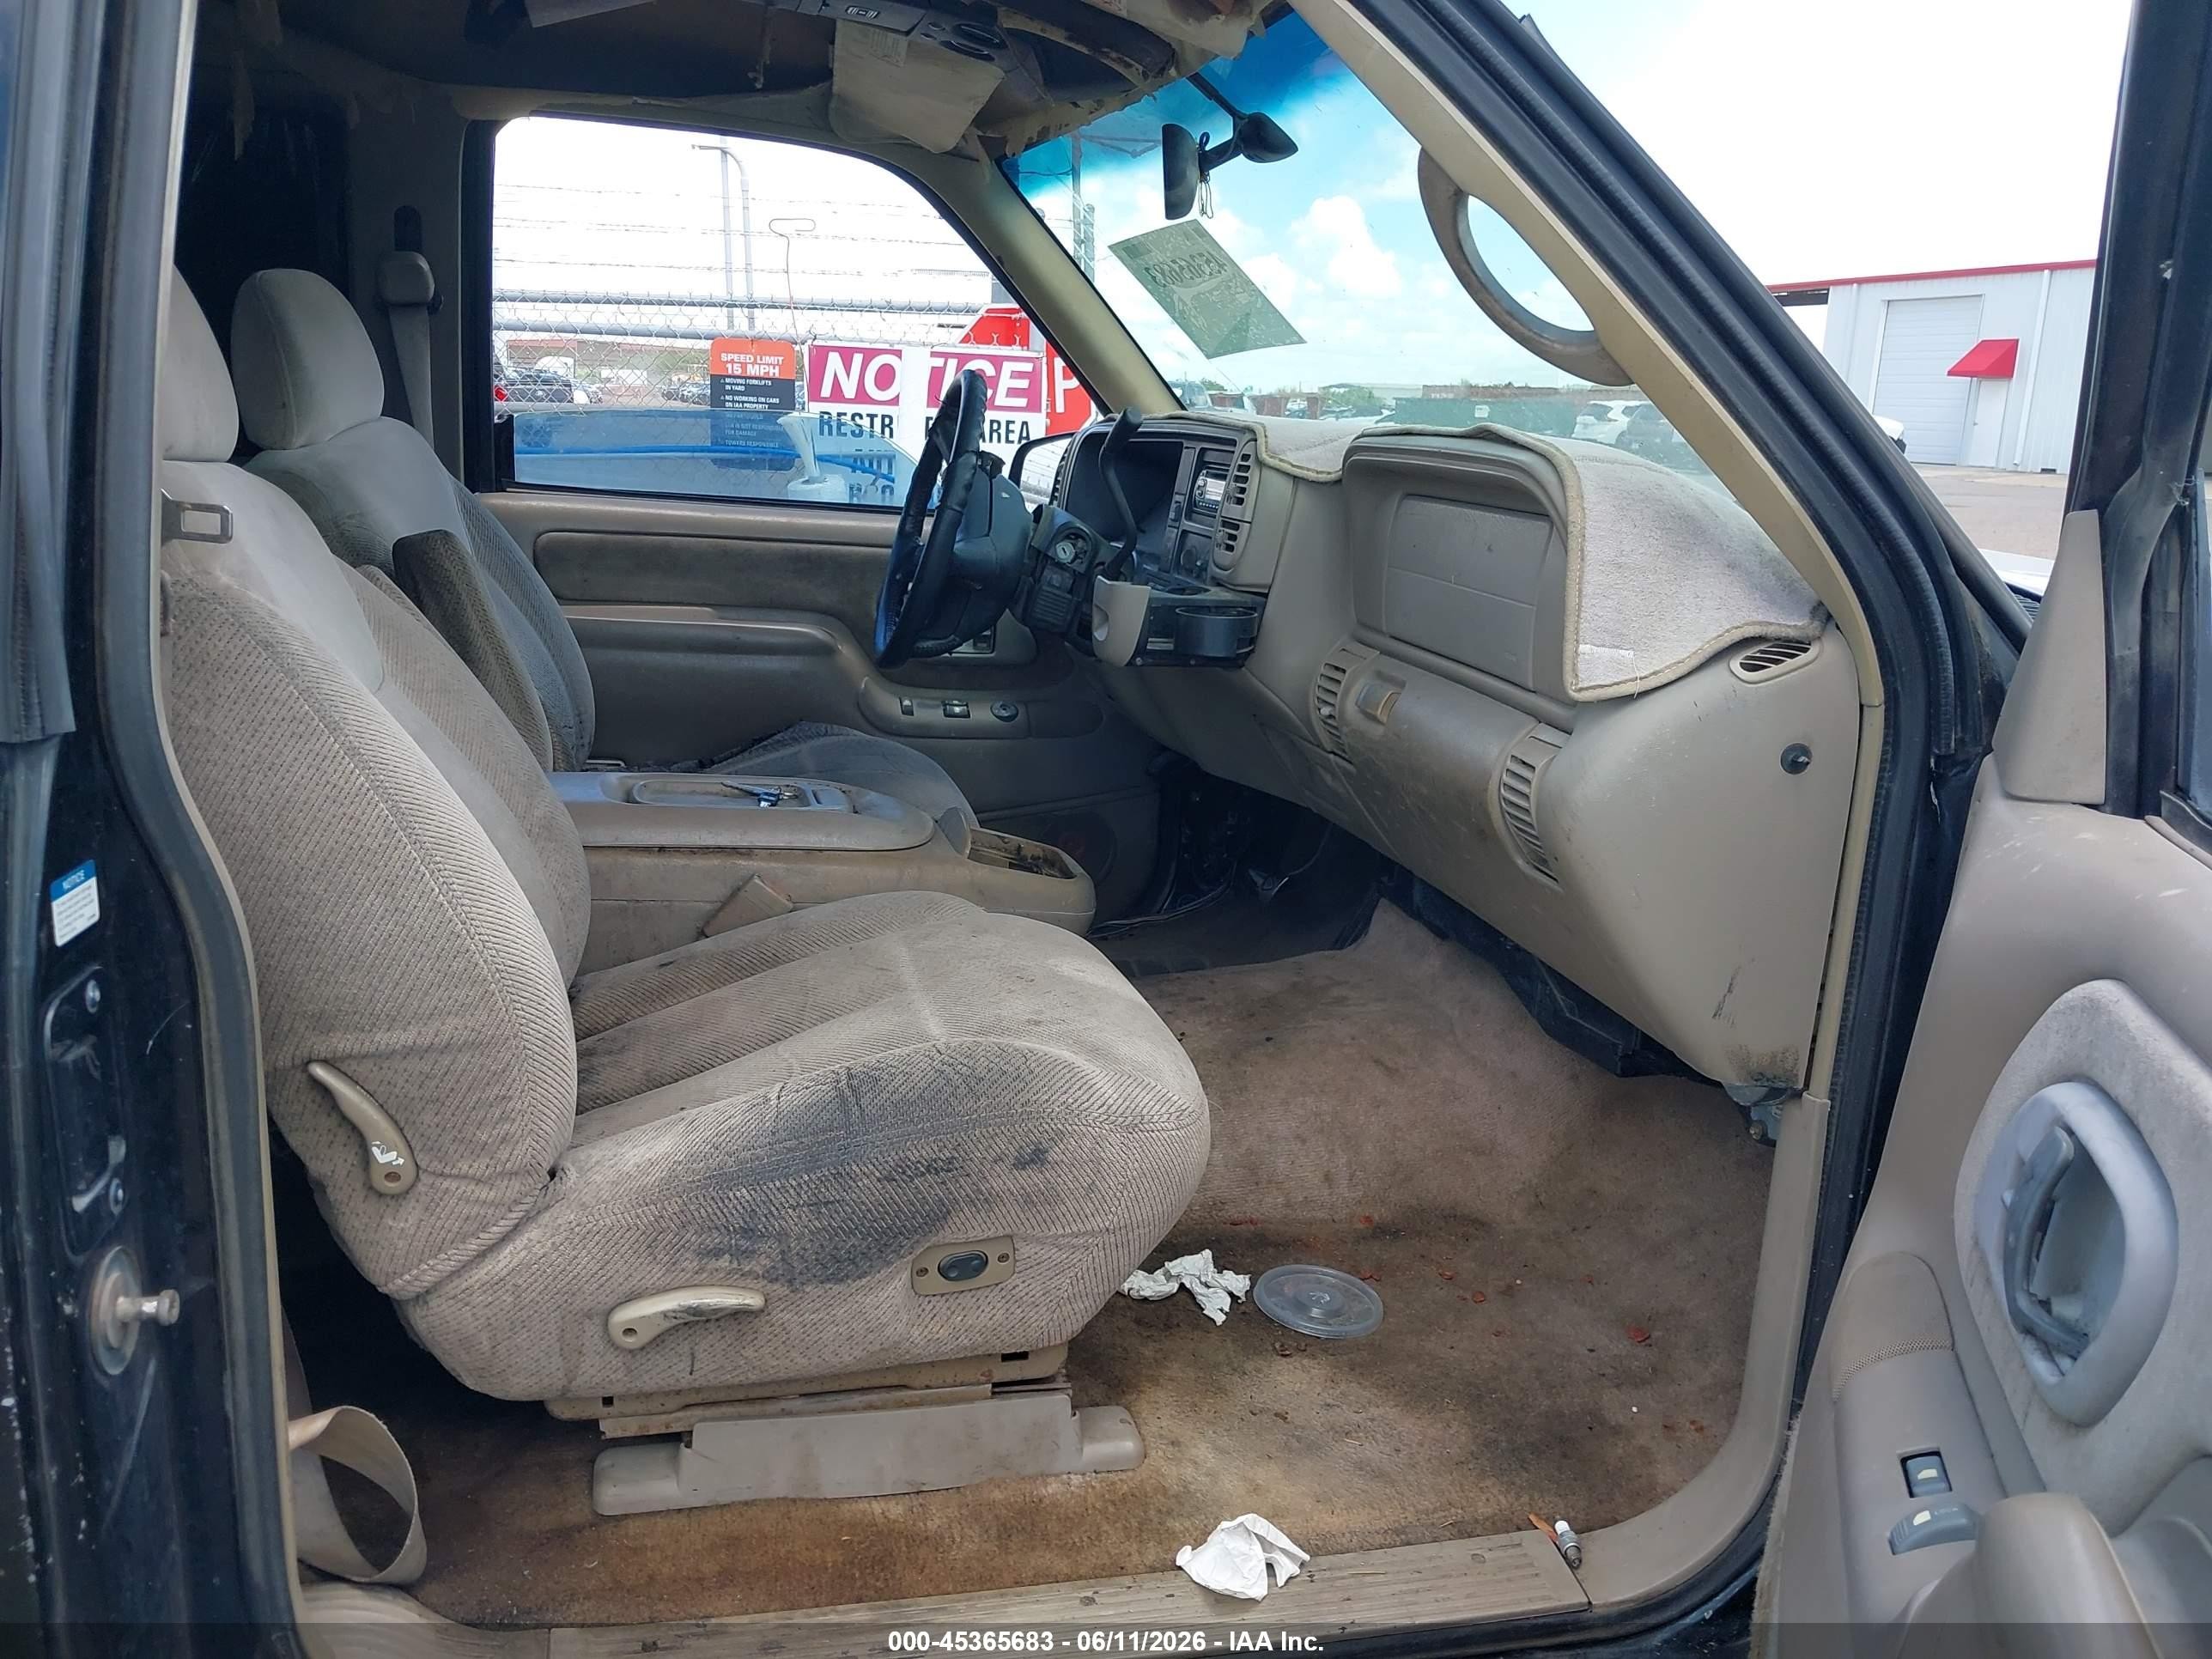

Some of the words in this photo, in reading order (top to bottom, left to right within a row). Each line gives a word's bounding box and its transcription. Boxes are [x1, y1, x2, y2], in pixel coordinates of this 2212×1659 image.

[720, 353, 755, 362] SPEED
[757, 355, 784, 365] LIMIT
[726, 362, 742, 374] 15
[746, 363, 780, 377] MPH
